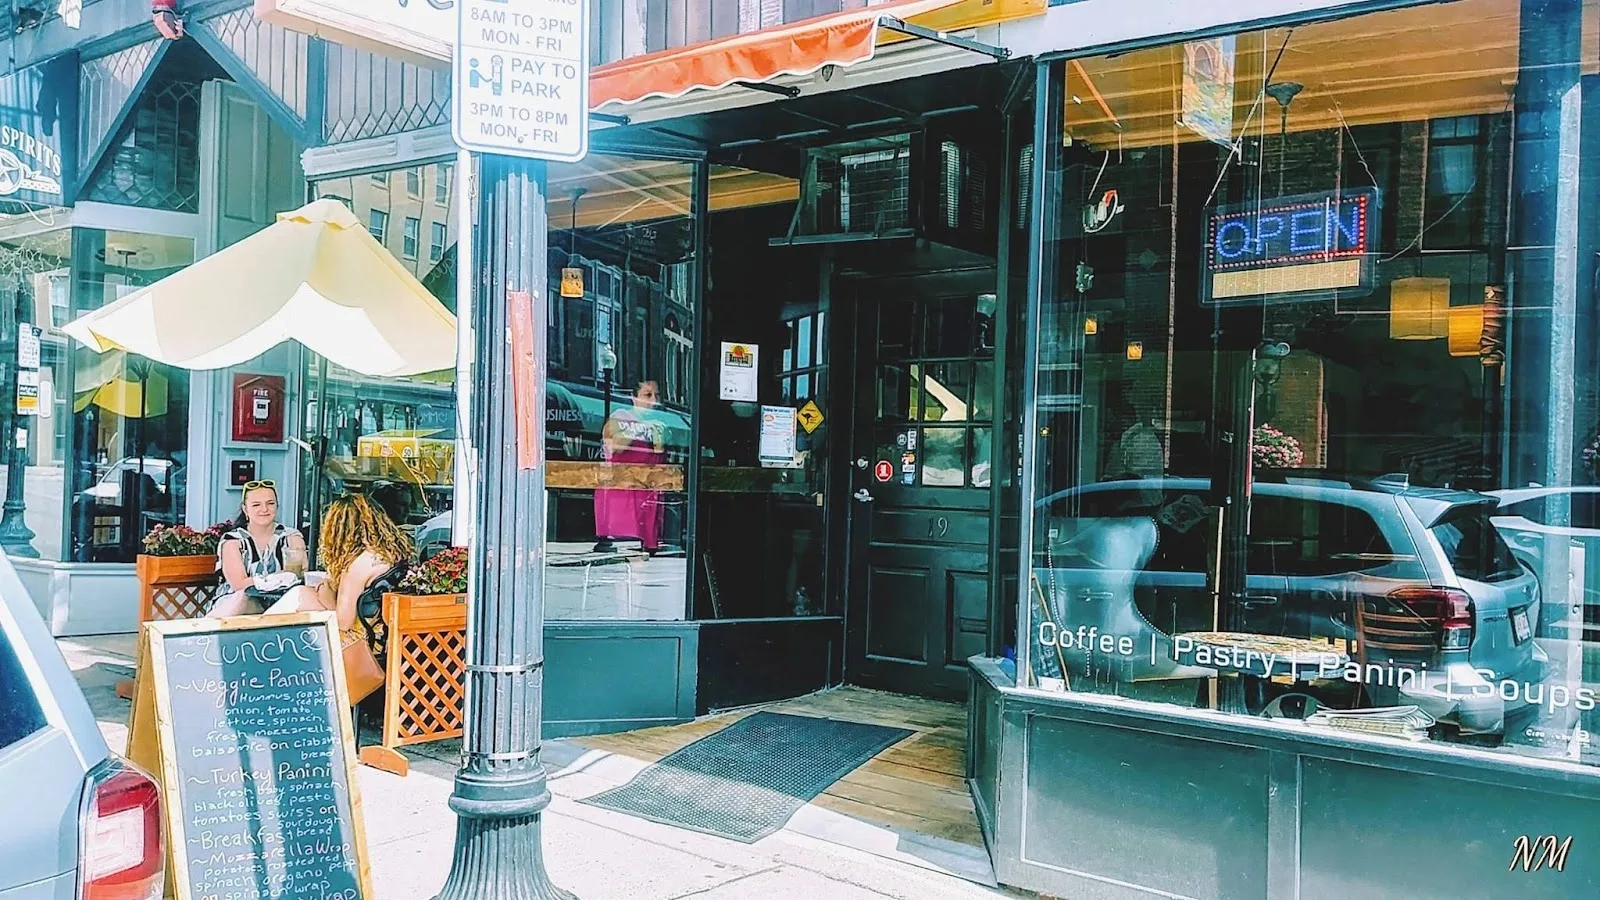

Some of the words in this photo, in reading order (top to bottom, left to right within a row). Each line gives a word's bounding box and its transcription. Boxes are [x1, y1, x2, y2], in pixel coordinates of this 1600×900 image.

[470, 7, 506, 24] 8AM
[512, 13, 534, 28] TO
[539, 18, 573, 33] 3PM
[481, 28, 520, 45] MON
[536, 36, 562, 52] FRI
[511, 58, 546, 75] PAY
[552, 63, 576, 79] TO
[511, 80, 562, 99] PARK
[470, 103, 504, 117] 3PM
[509, 107, 531, 121] TO
[535, 110, 569, 125] 8PM
[480, 123, 517, 137] MON
[533, 128, 559, 143] FRI
[1, 124, 62, 176] SPIRITS
[1215, 206, 1359, 259] OPEN
[546, 409, 583, 421] USINESS
[1038, 621, 1134, 656] Coffee
[1173, 636, 1276, 679] Pastry
[1318, 652, 1427, 690] Panini
[1471, 668, 1596, 714] Soups
[269, 668, 325, 688] Panini
[270, 740, 289, 751] on
[301, 750, 334, 760] bread
[278, 762, 332, 781] Panini
[216, 787, 253, 799] fresh
[194, 800, 235, 812] black
[268, 807, 314, 820] swiss
[320, 805, 338, 814] on
[296, 826, 333, 837] bread
[267, 856, 315, 871] roasted
